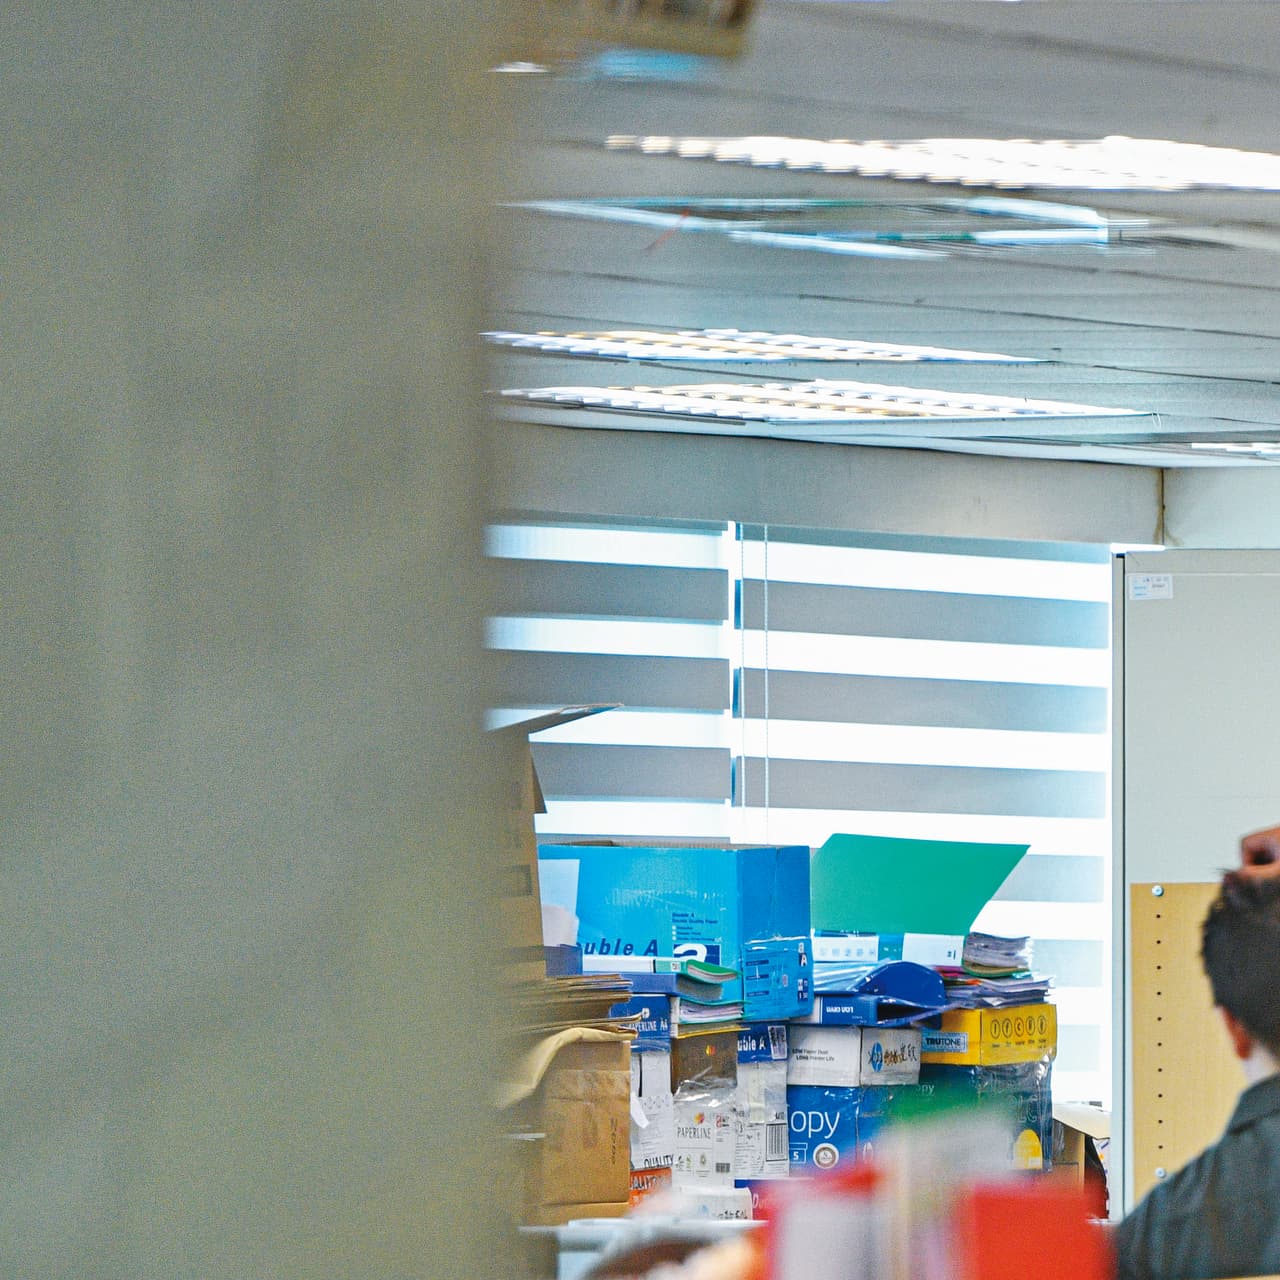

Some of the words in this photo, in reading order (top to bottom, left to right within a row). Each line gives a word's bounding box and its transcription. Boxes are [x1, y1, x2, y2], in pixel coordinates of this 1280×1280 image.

[576, 938, 633, 956] uble
[926, 1037, 961, 1047] TRUTONE
[790, 1111, 840, 1139] opy
[677, 1127, 711, 1139] PAPERLINE
[643, 1154, 674, 1168] QUALITY
